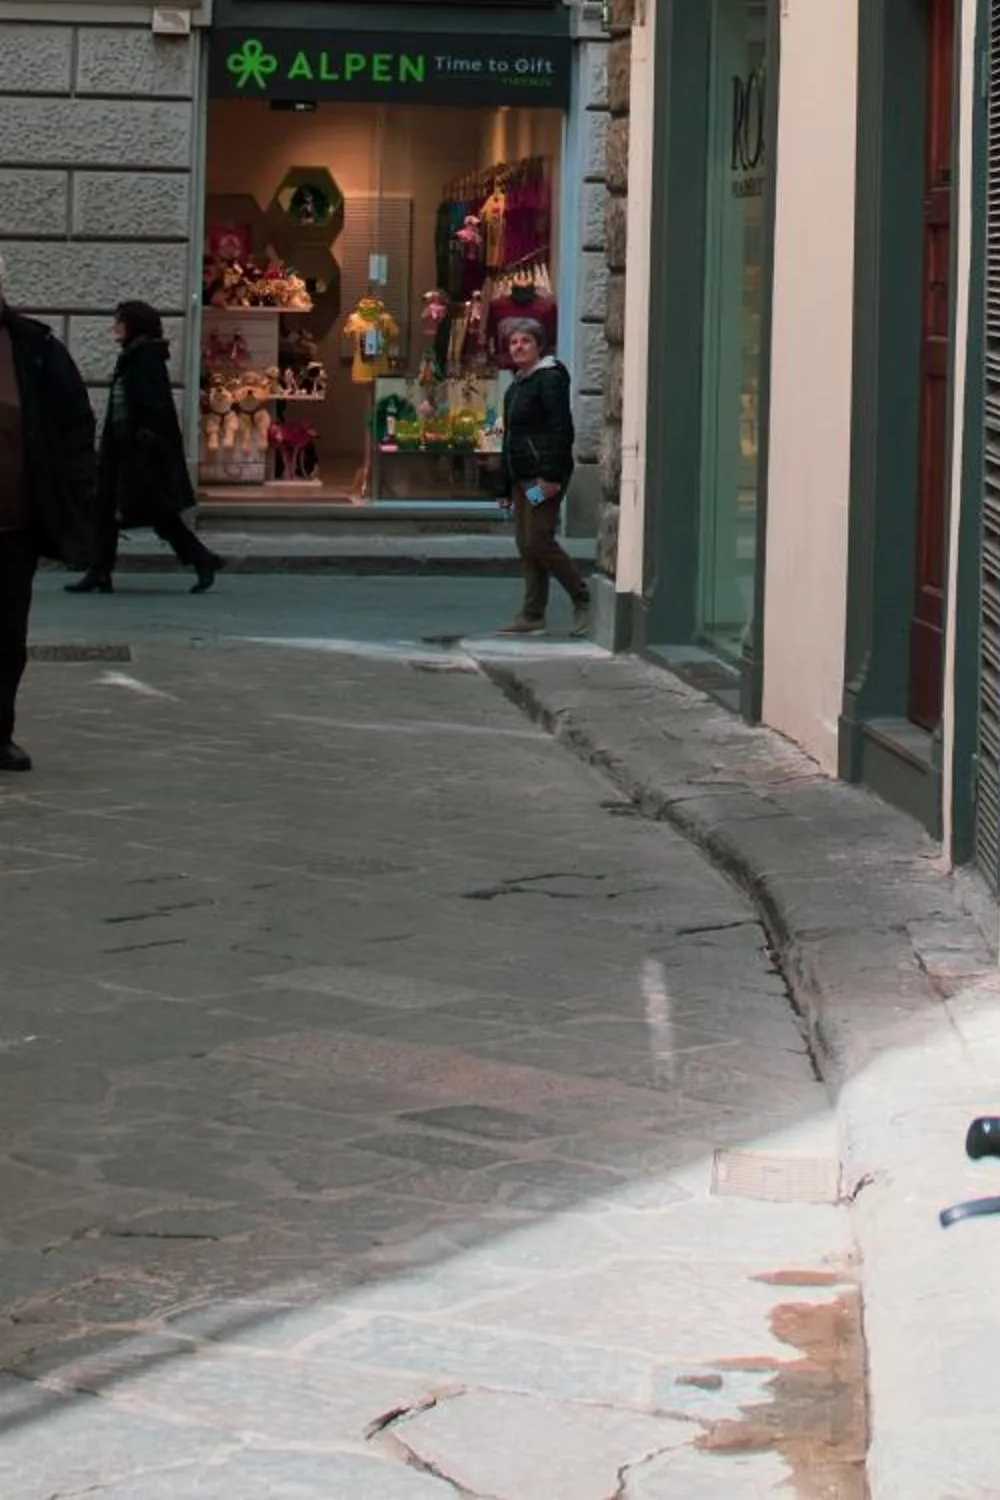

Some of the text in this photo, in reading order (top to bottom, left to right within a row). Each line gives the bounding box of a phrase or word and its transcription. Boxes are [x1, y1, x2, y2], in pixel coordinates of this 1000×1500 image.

[288, 52, 424, 83] ALPEN
[434, 56, 555, 74] Time to Gift
